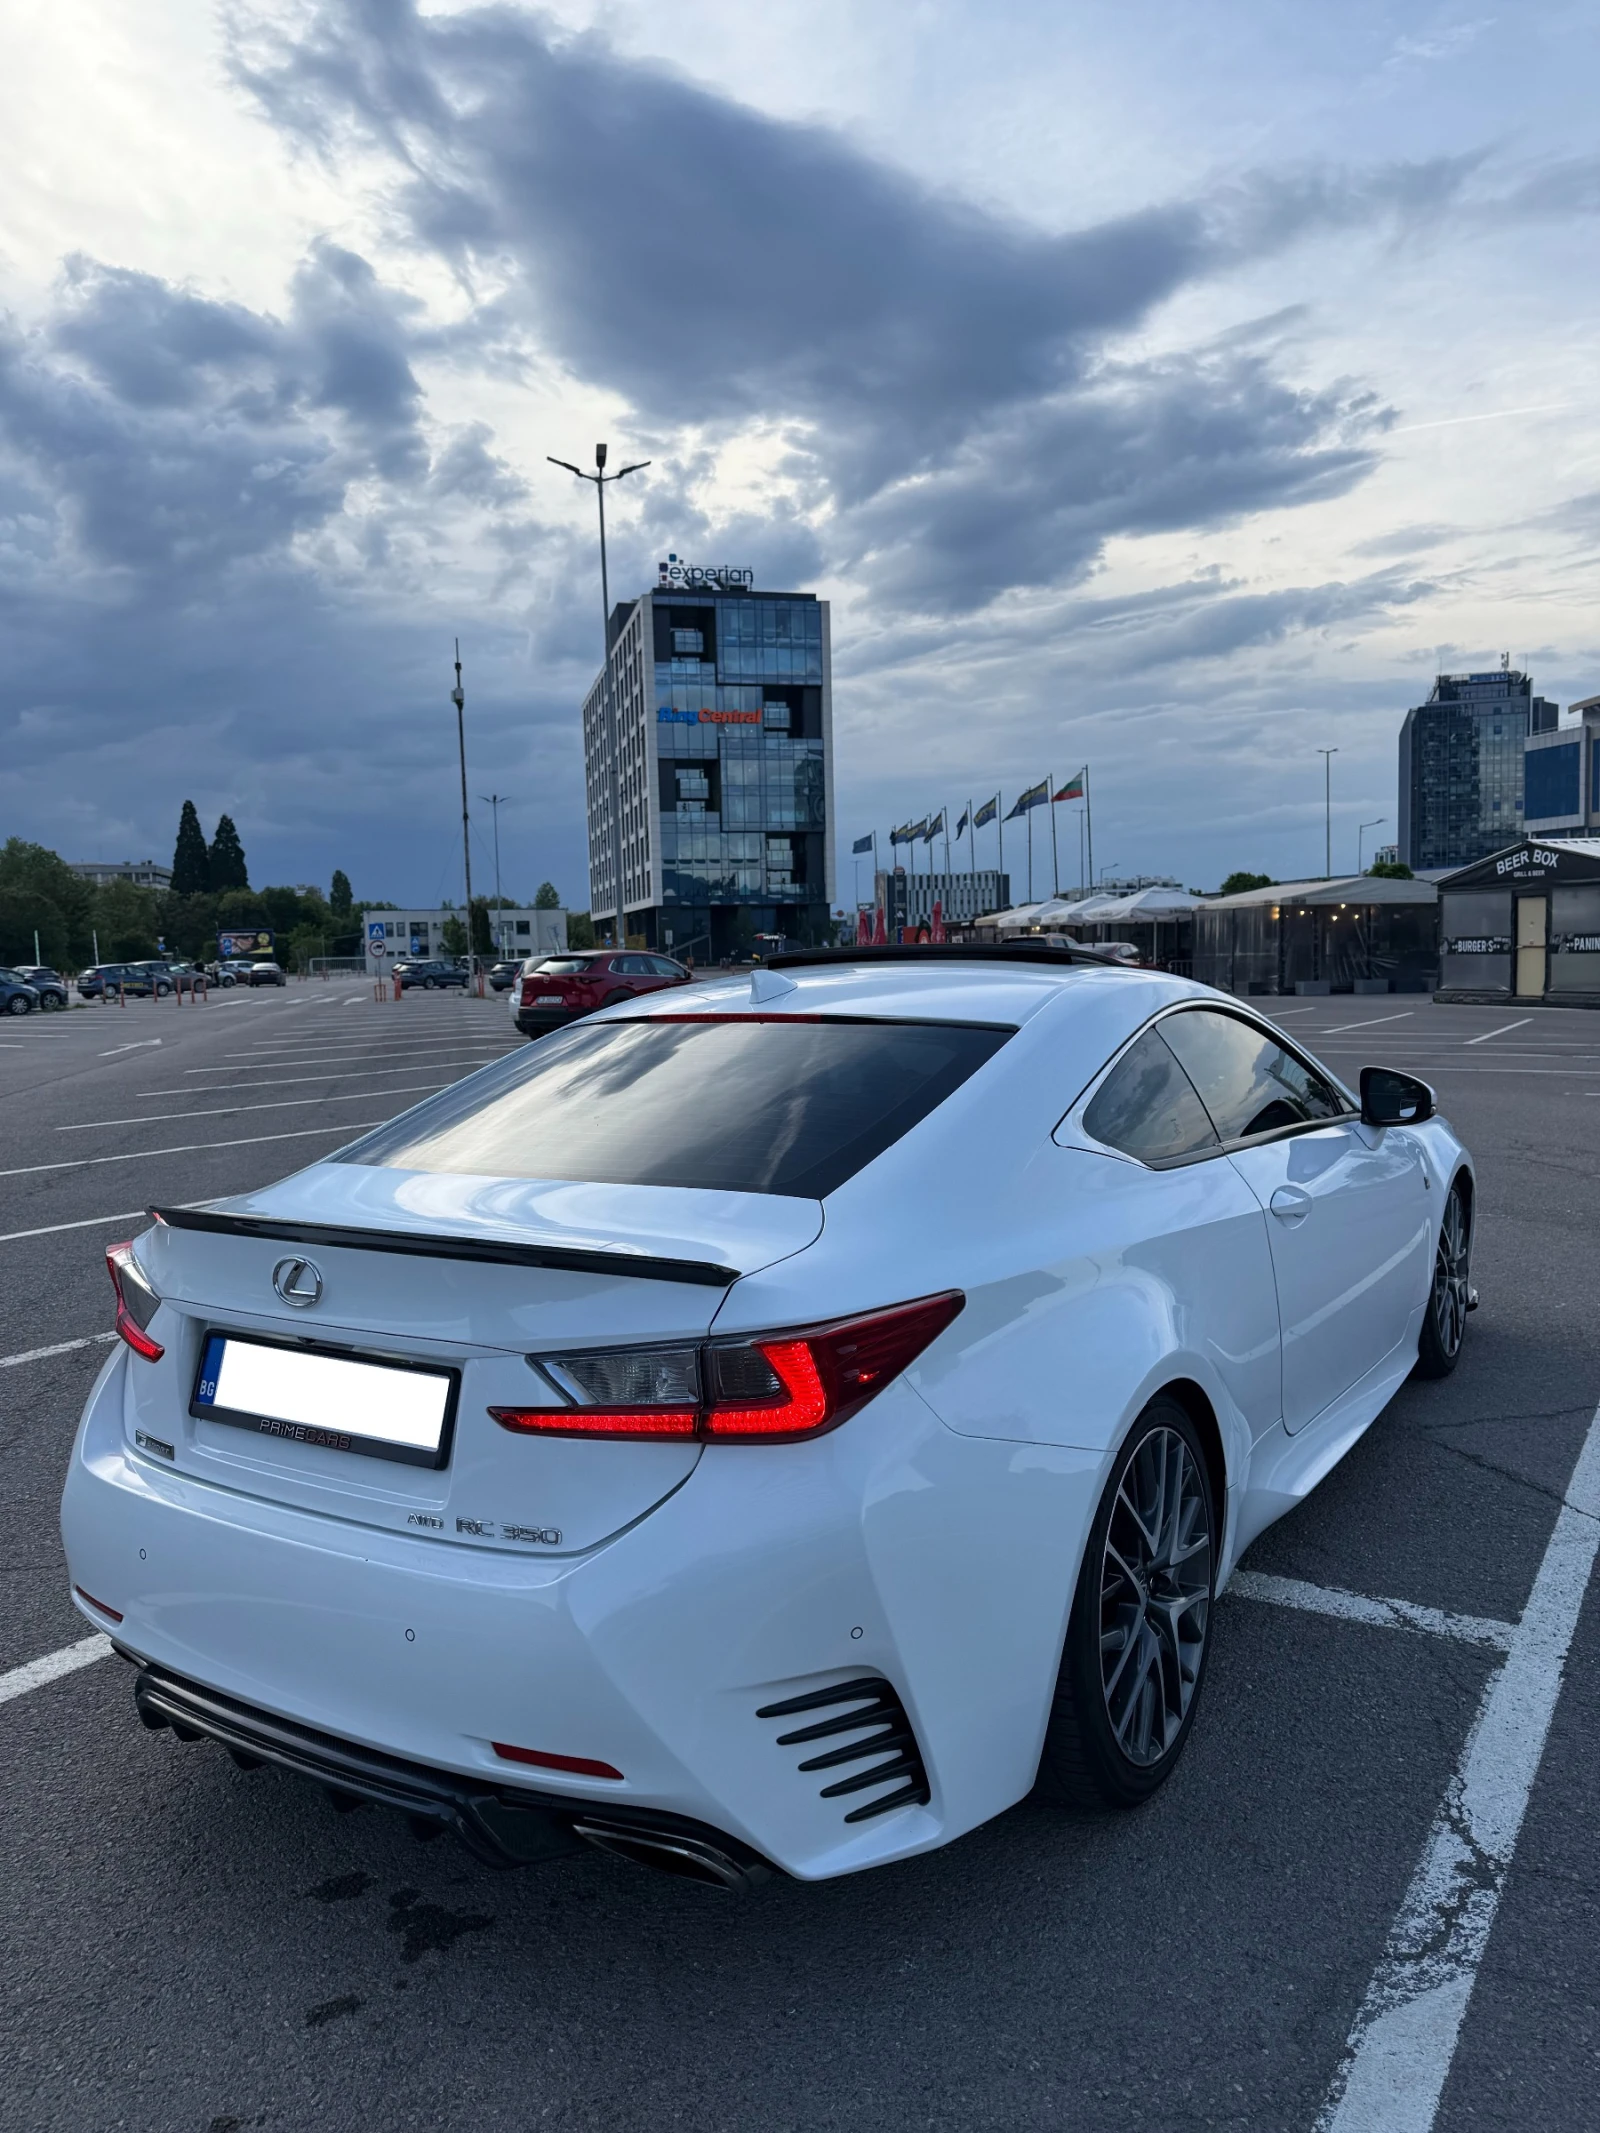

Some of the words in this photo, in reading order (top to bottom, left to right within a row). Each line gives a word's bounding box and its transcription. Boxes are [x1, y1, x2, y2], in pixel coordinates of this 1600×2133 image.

[669, 565, 754, 585] experian
[657, 707, 762, 726] RingCentral
[1496, 850, 1530, 875] BEER
[1532, 849, 1560, 868] BOX
[199, 1379, 215, 1397] BG
[407, 1512, 444, 1530] AWD
[456, 1516, 494, 1538] RC
[499, 1522, 563, 1546] 350
